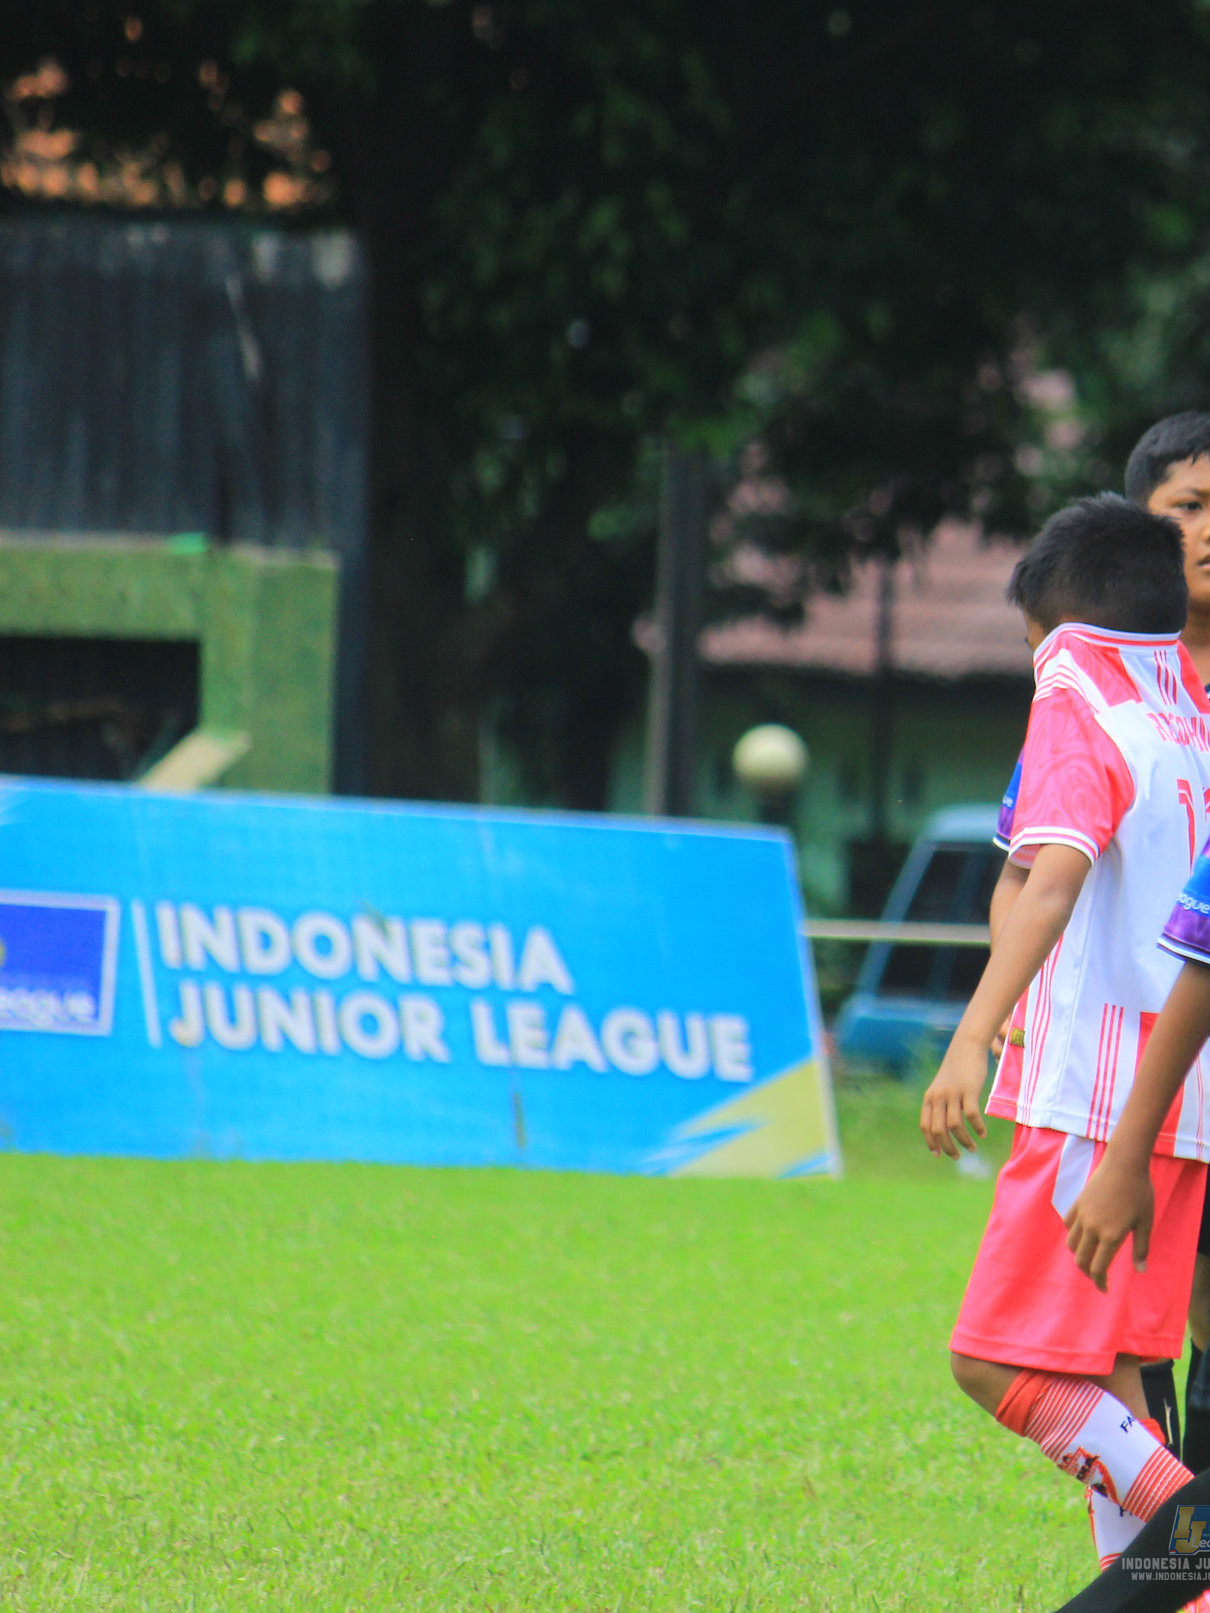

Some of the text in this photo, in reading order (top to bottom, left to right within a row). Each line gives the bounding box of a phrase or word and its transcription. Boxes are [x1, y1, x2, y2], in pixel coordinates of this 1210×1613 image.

[156, 900, 574, 995] INDONESIA
[170, 978, 753, 1082] JUNIOR LEAGUE
